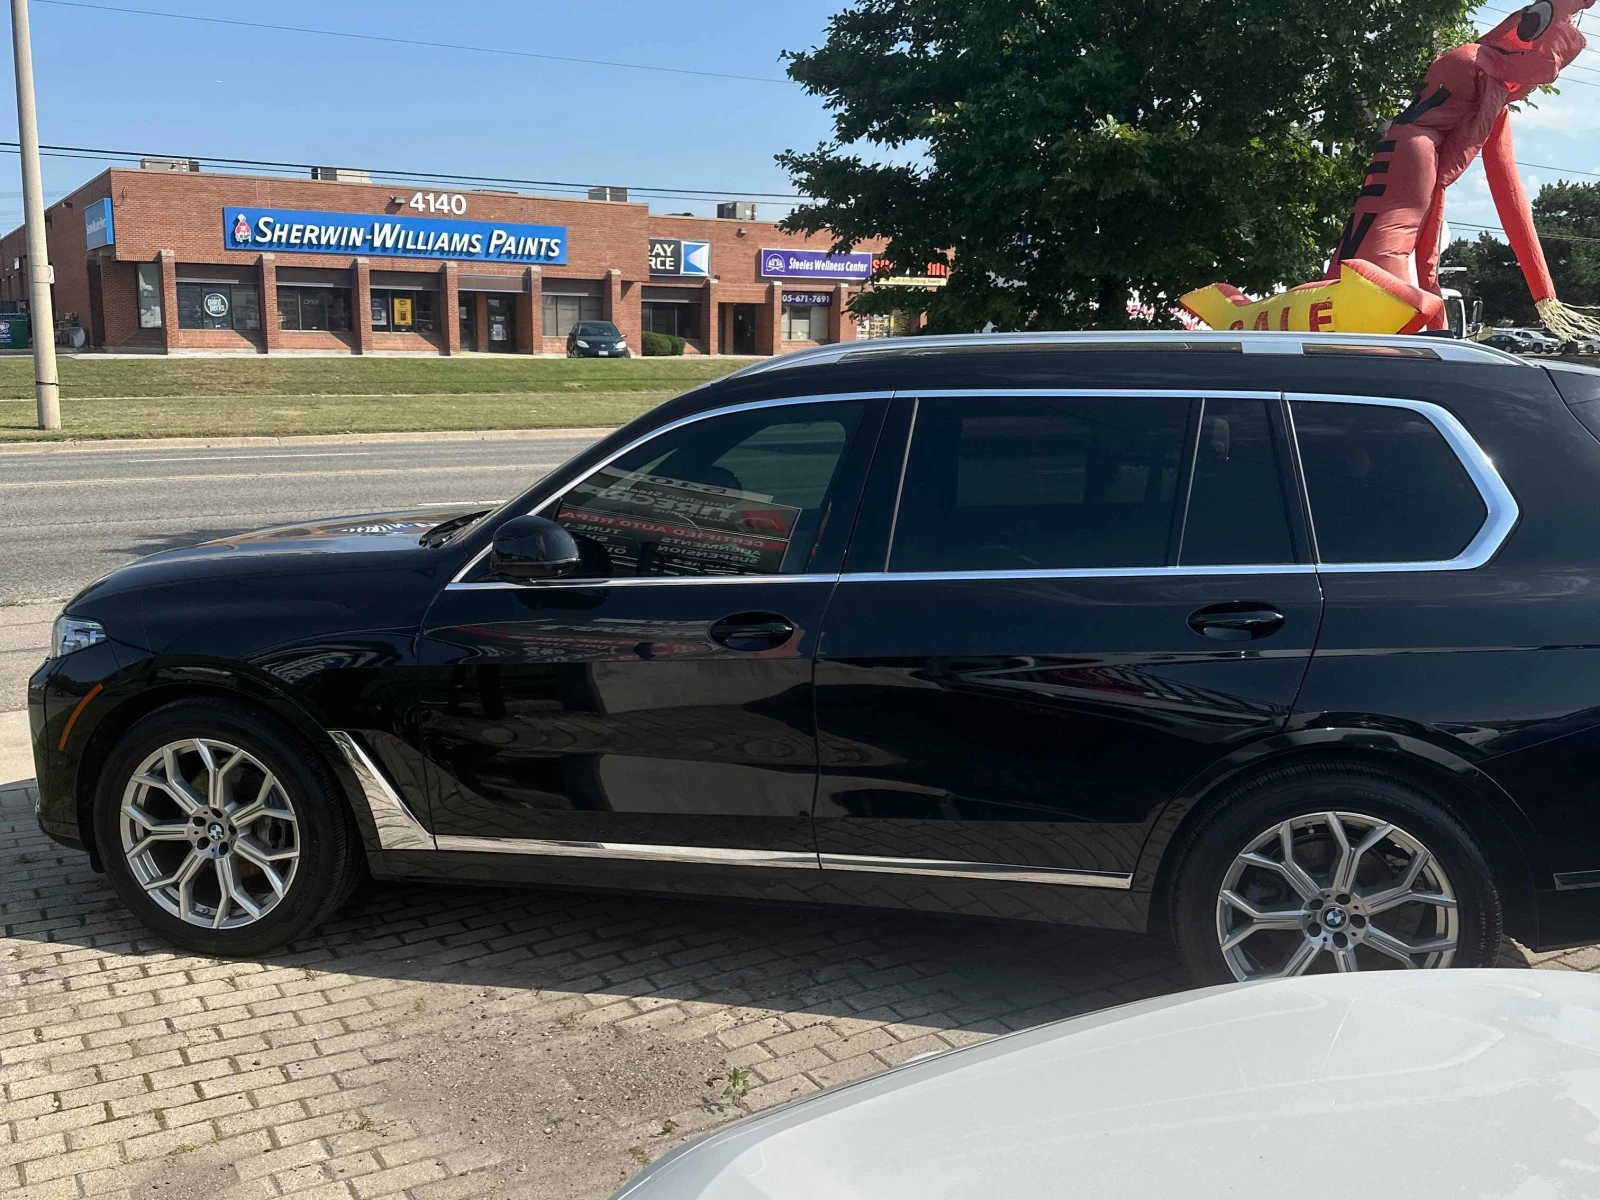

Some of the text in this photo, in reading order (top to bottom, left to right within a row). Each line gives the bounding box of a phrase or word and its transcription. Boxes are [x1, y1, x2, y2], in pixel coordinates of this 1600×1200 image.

[408, 192, 467, 215] 4140
[255, 216, 561, 257] SHERWIN-WILLIAMS PAINTS
[788, 257, 813, 270] Steeles
[814, 259, 844, 272] Wellness
[845, 261, 868, 272] Center
